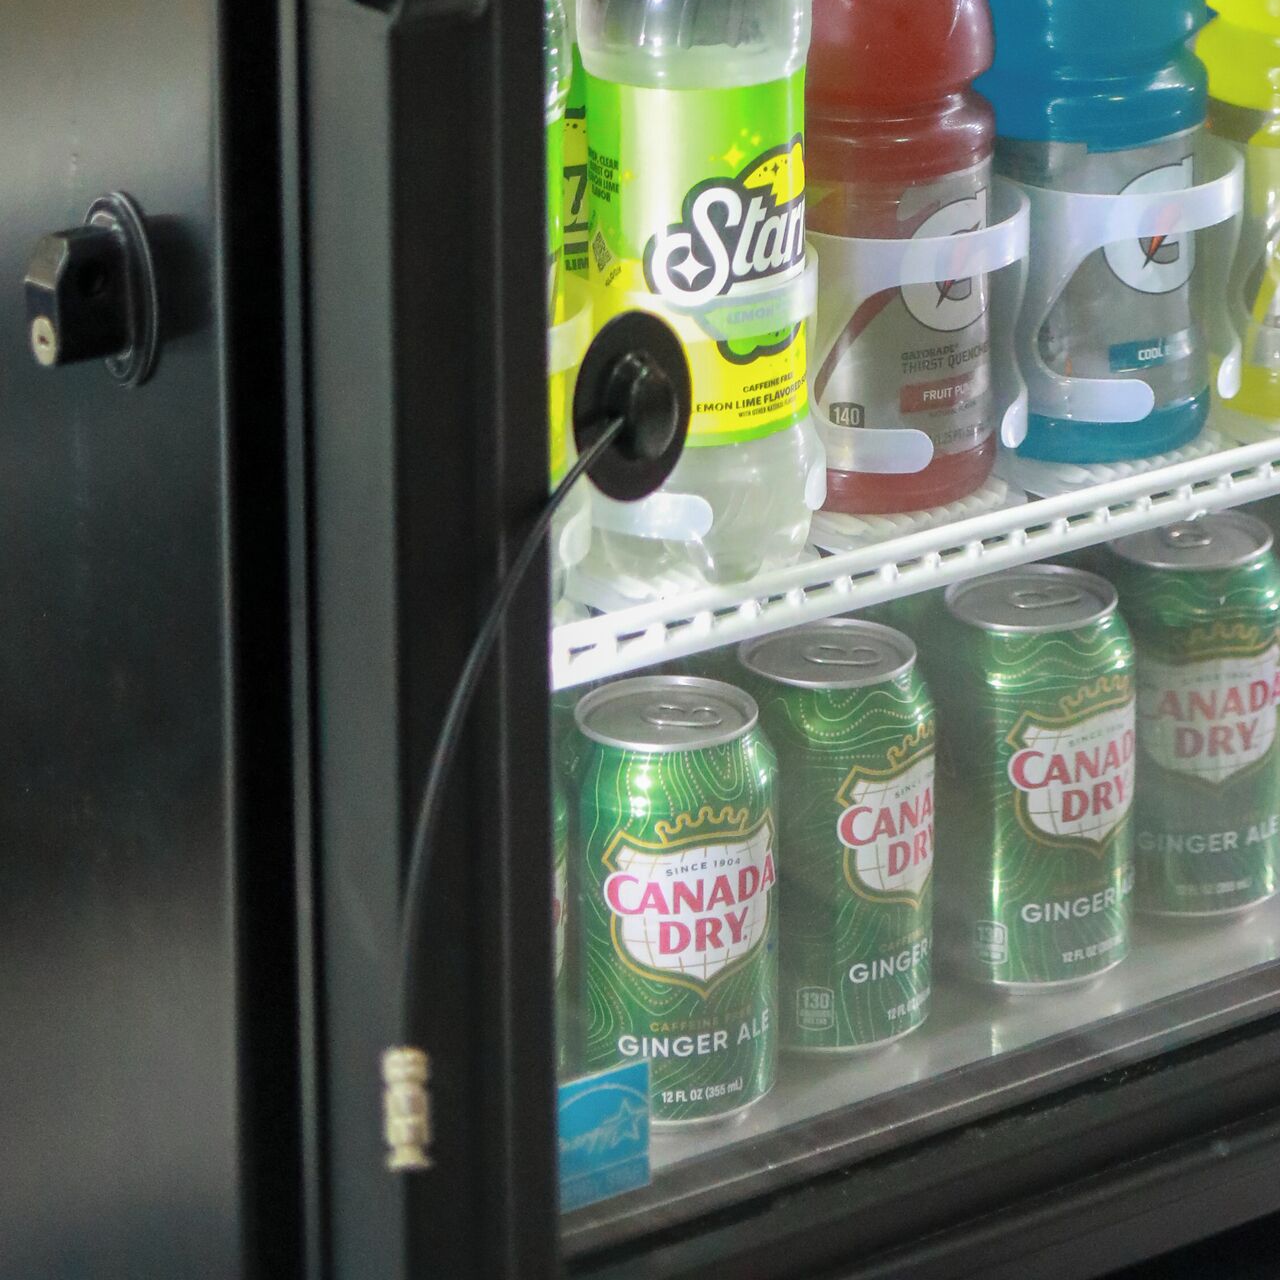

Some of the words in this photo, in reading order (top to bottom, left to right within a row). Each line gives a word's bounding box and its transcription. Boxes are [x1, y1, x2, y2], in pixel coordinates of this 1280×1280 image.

[650, 186, 805, 307] Star
[902, 357, 945, 374] THIRST
[948, 342, 990, 370] QUENCHE
[1137, 343, 1164, 361] COOL
[696, 401, 733, 413] EMON
[735, 395, 761, 410] LIME
[763, 380, 801, 404] FLAVORED
[742, 377, 780, 393] CAFFEINE
[922, 386, 953, 402] FRUIT
[834, 406, 860, 426] 140
[1173, 717, 1260, 759] DRY
[1012, 729, 1135, 790] CANAD
[841, 787, 933, 847] CANA
[1138, 830, 1239, 854] GINGER
[1246, 814, 1280, 846] ALE
[607, 852, 775, 915] CANADA
[666, 861, 708, 877] SINCE
[712, 857, 742, 869] 1904
[1020, 886, 1116, 924] GINGER
[658, 906, 748, 956] DRY
[849, 937, 928, 984] GINGER
[802, 992, 830, 1009] 130
[618, 1030, 729, 1058] GINGER
[736, 1007, 769, 1046] ALE
[661, 1091, 674, 1104] 12
[675, 1090, 687, 1103] FL
[690, 1088, 703, 1102] OZ
[705, 1083, 726, 1101] (355
